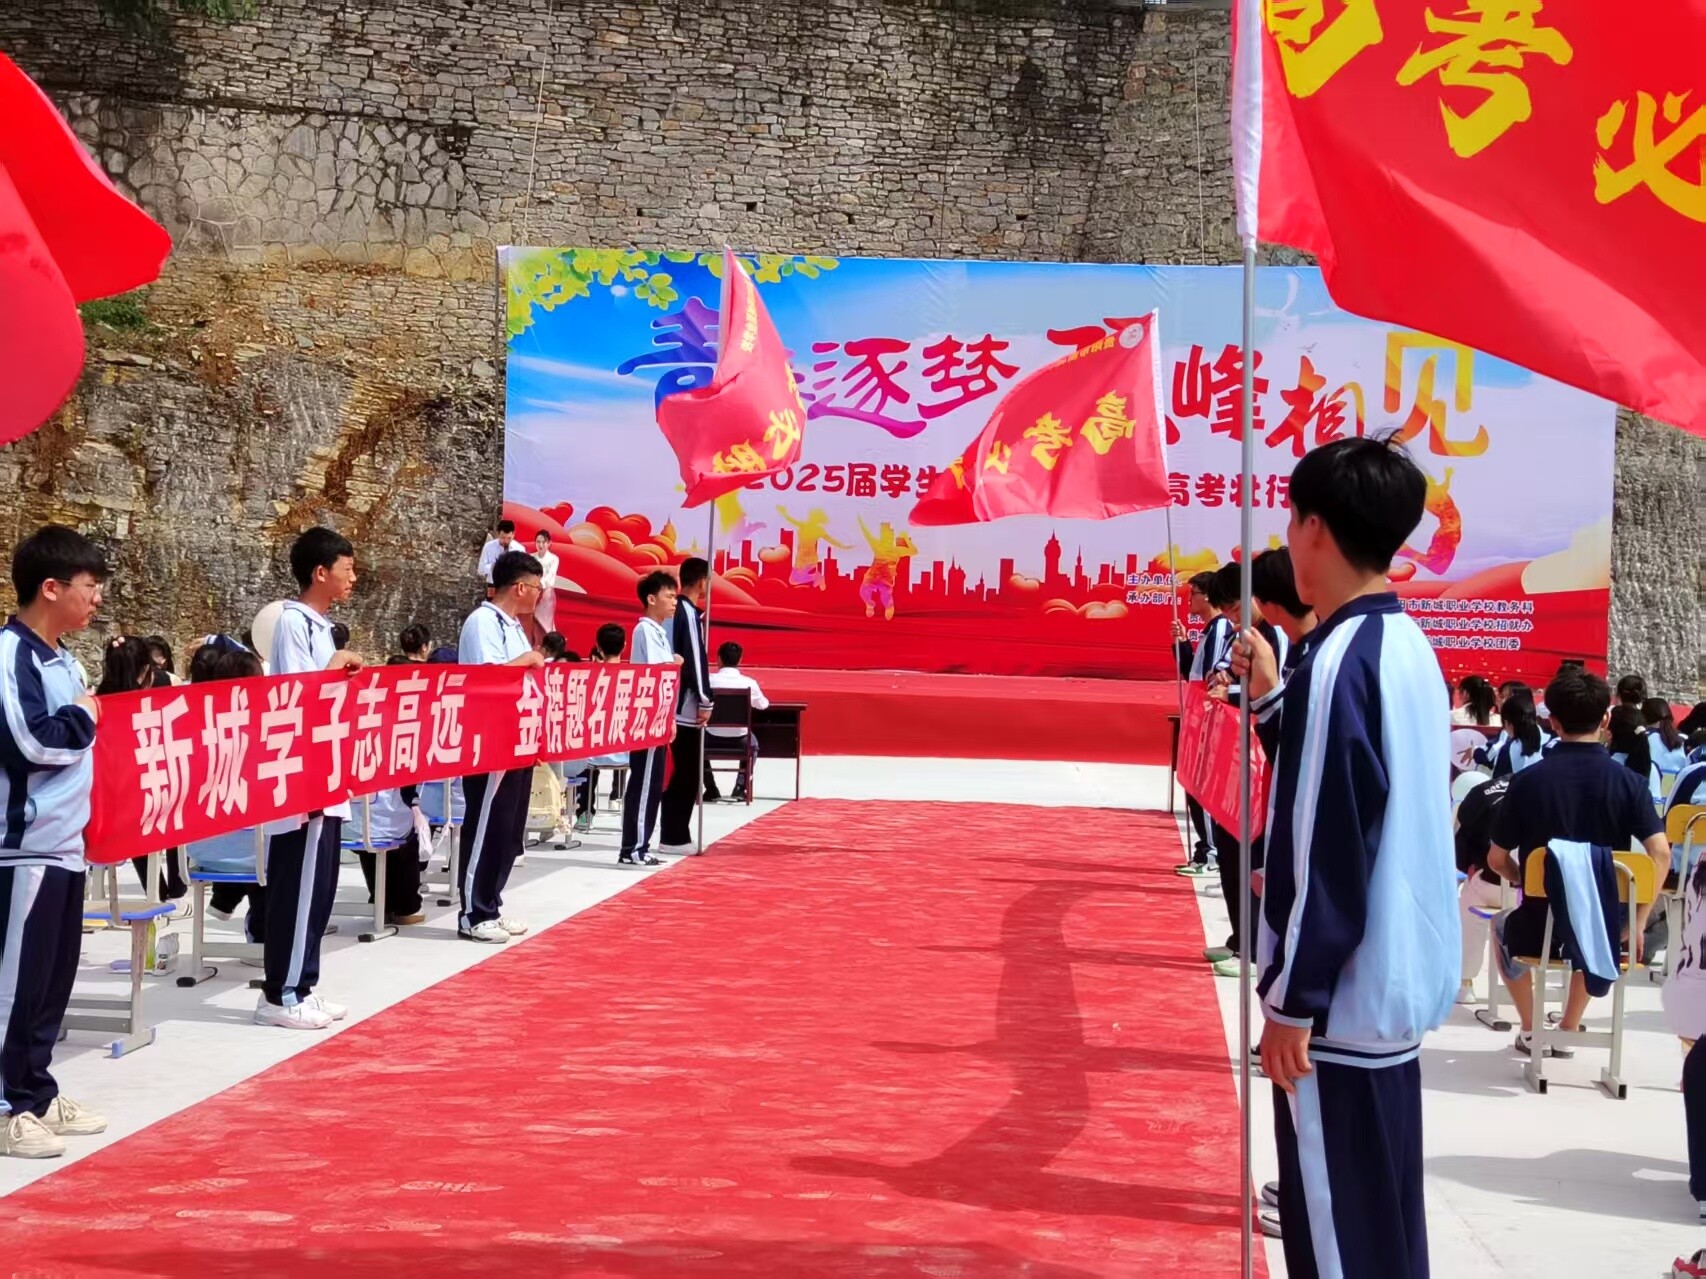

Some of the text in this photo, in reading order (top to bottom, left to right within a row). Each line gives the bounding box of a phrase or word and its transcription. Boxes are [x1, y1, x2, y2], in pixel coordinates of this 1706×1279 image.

[617, 296, 1021, 438] 青逐梦
[744, 462, 946, 499] 025届学生
[1414, 617, 1534, 632] 新城职业学校招就办
[1427, 635, 1521, 650] 城职业学校团委
[514, 666, 677, 758] 金榜题名展宏愿
